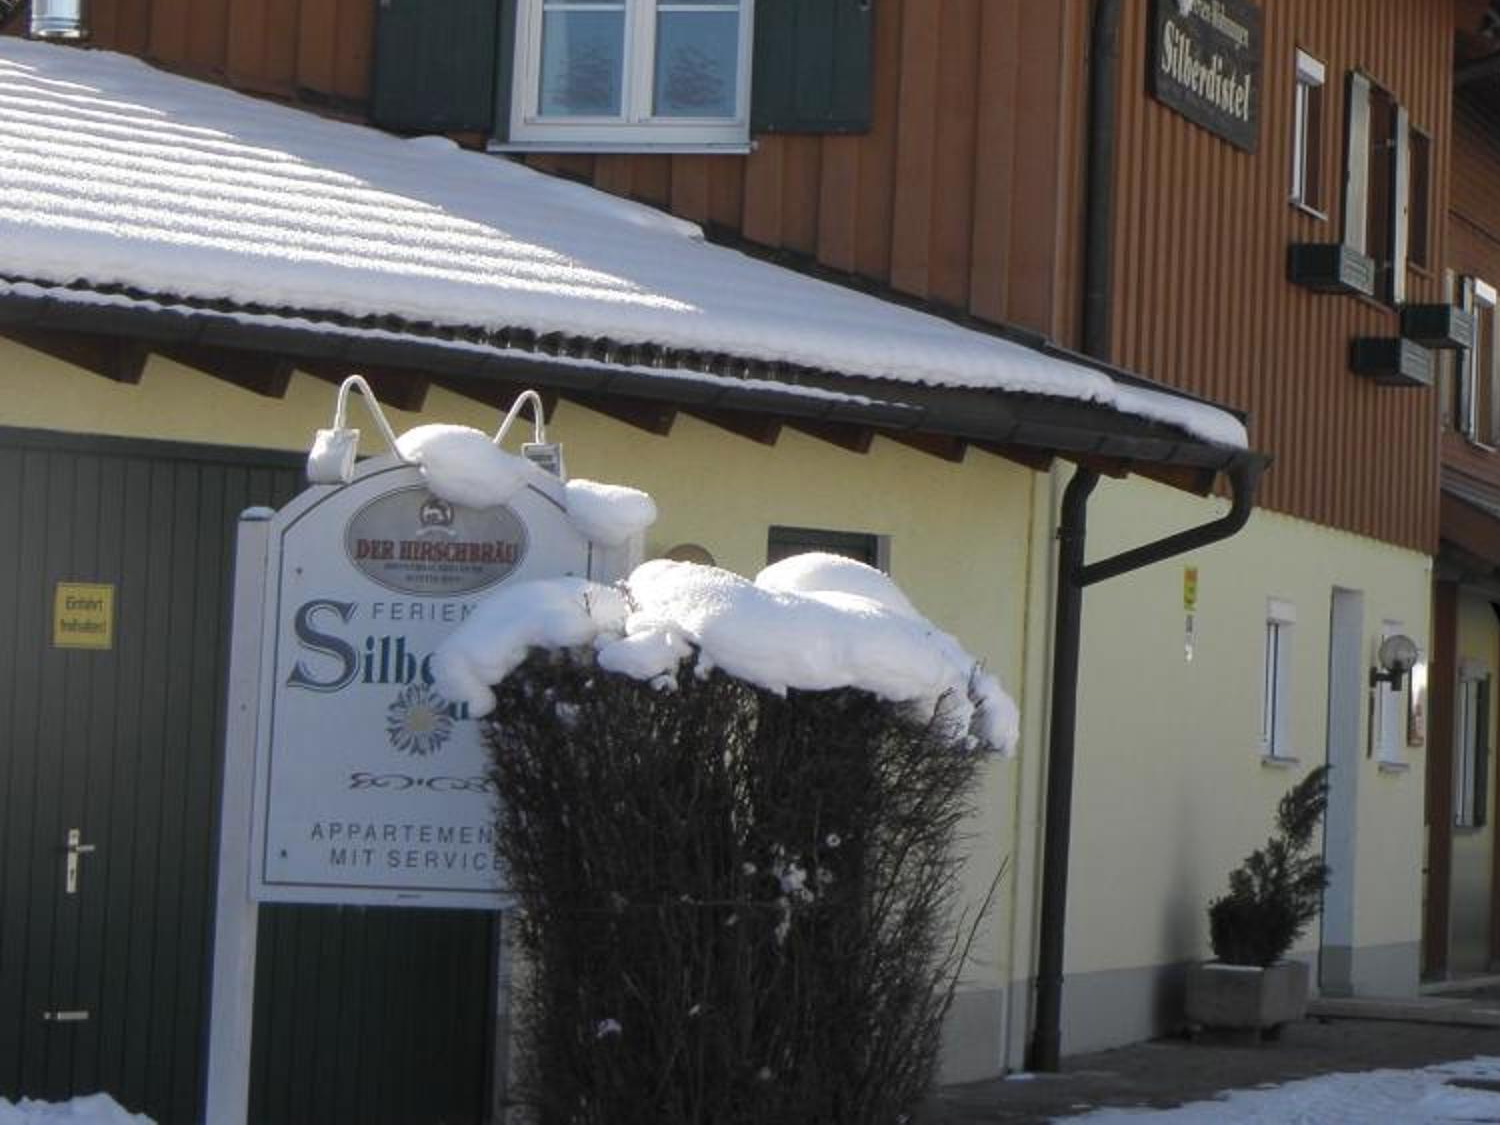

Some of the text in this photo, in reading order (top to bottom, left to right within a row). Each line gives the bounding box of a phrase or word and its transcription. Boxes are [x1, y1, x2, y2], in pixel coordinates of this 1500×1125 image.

[1161, 20, 1250, 122] Silberdistel
[354, 539, 394, 560] DER
[372, 602, 478, 623] FERIEN
[310, 823, 496, 845] APPARTEMEN
[329, 848, 507, 872] MIT SERVICE
